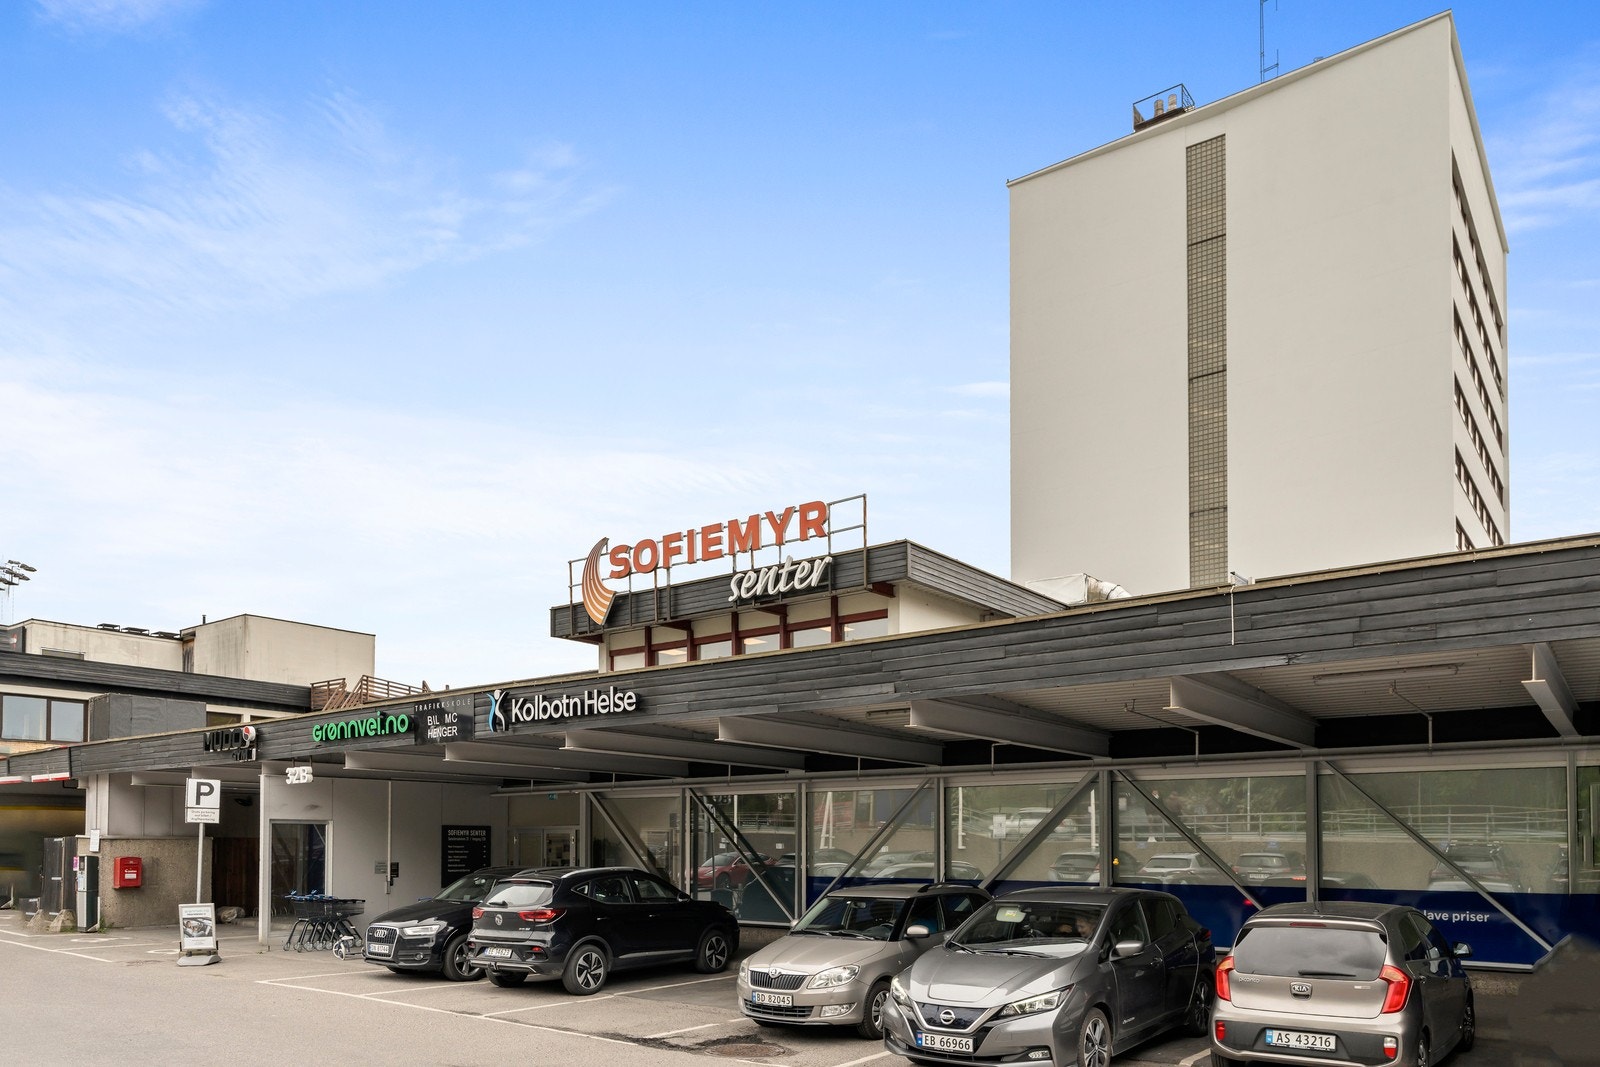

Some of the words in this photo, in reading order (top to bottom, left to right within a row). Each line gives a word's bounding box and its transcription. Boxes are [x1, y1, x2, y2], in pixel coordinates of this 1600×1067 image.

[609, 500, 829, 579] SOFIEMYR
[728, 555, 833, 602] senter
[414, 699, 471, 712] TRAFIKKSKOLE
[511, 694, 581, 723] Kolbotn
[584, 686, 637, 715] Helse
[427, 715, 440, 726] BIL
[445, 712, 458, 724] MC
[427, 726, 458, 739] HENGER
[285, 766, 313, 785] 32B
[195, 781, 215, 805] P
[1452, 911, 1490, 923] priser
[1293, 984, 1308, 992] KIA
[756, 992, 766, 1003] BD
[767, 994, 791, 1005] 82045
[924, 1033, 936, 1046] EB
[939, 1035, 971, 1050] 66966
[1276, 1032, 1291, 1044] AS
[1295, 1034, 1331, 1048] 43216
